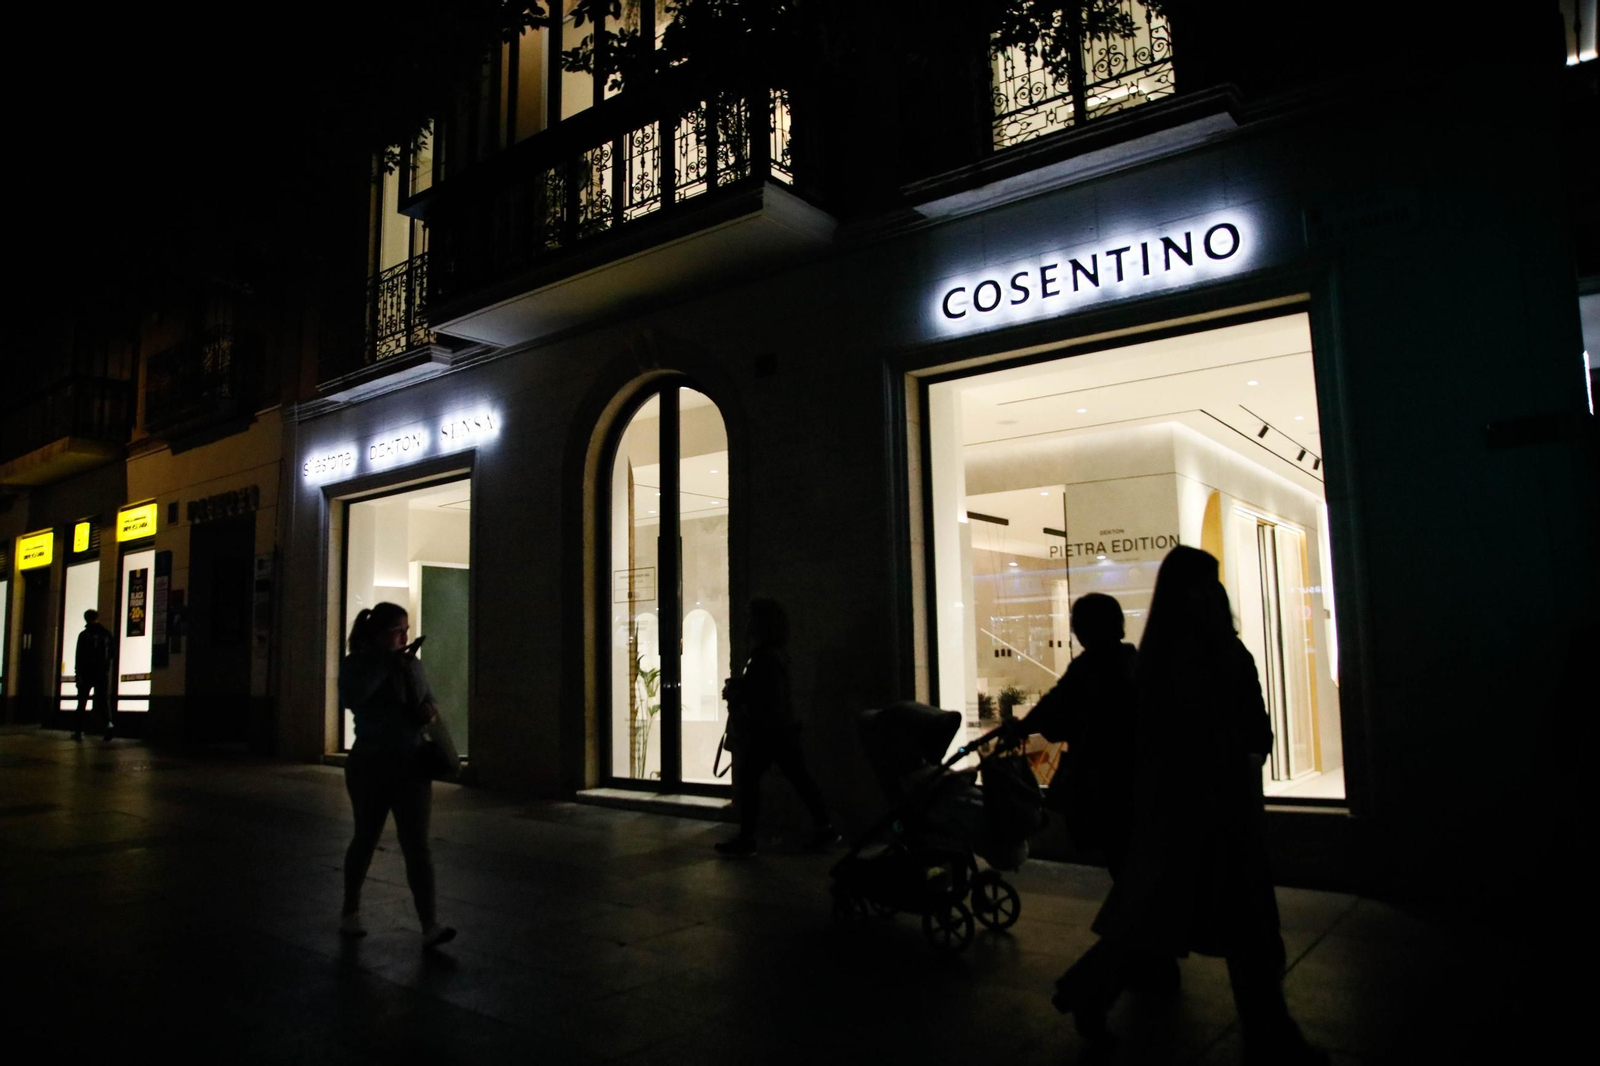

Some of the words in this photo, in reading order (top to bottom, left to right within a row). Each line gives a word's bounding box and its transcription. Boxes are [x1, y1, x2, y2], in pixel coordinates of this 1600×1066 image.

[942, 222, 1241, 320] COSENTINO
[369, 432, 421, 461] DEKTON
[1049, 541, 1107, 558] PIETRA
[1112, 534, 1180, 553] EDITION
